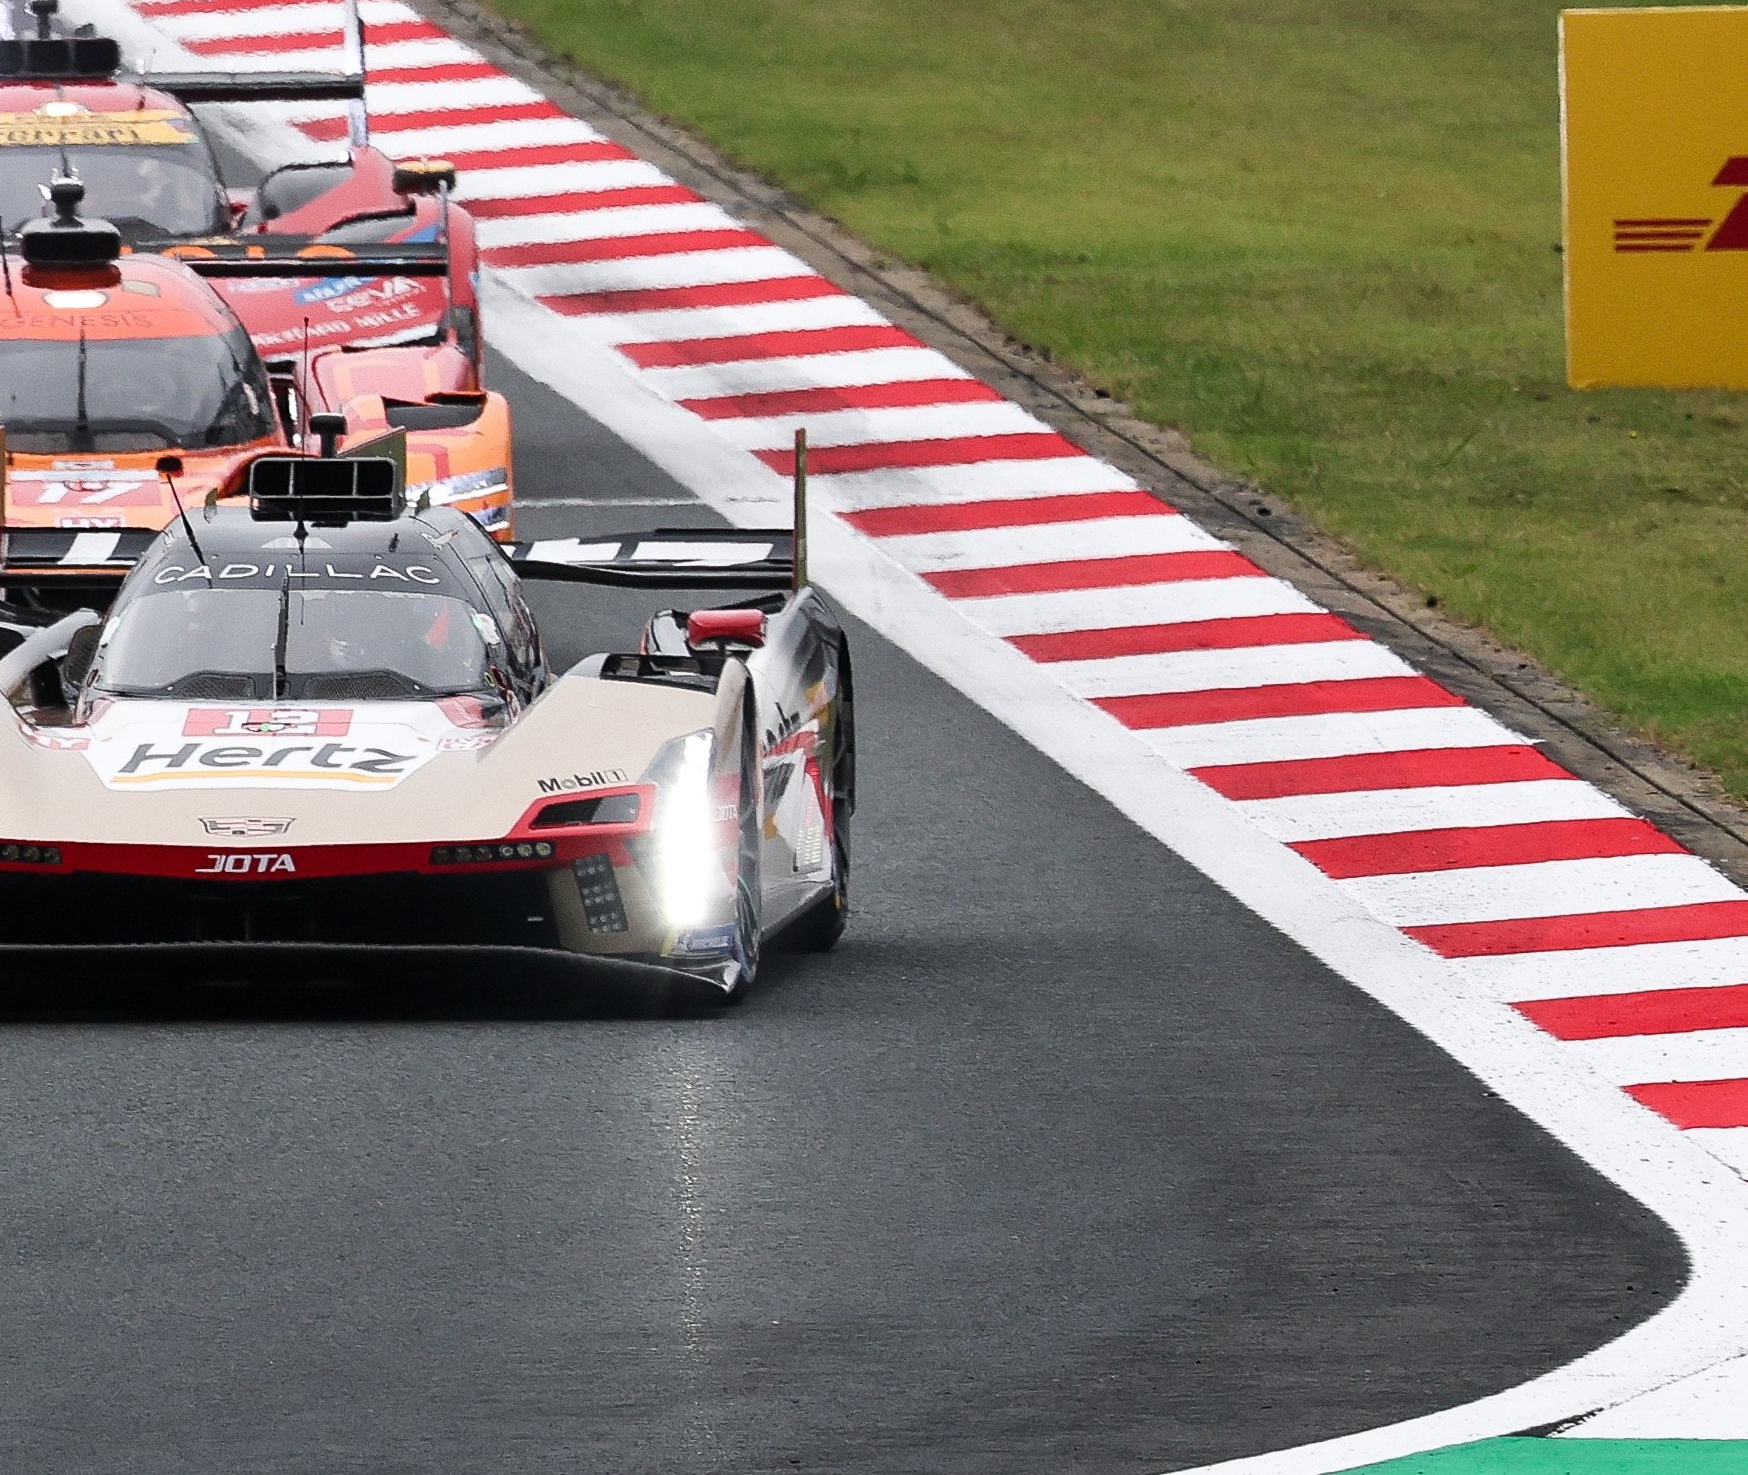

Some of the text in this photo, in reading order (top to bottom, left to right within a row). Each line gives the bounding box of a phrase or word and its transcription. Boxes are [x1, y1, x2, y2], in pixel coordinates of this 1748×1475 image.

[154, 564, 440, 585] CADILLAC
[117, 742, 416, 774] Hertz
[537, 772, 606, 794] Mobil
[194, 854, 296, 873] JOTA
